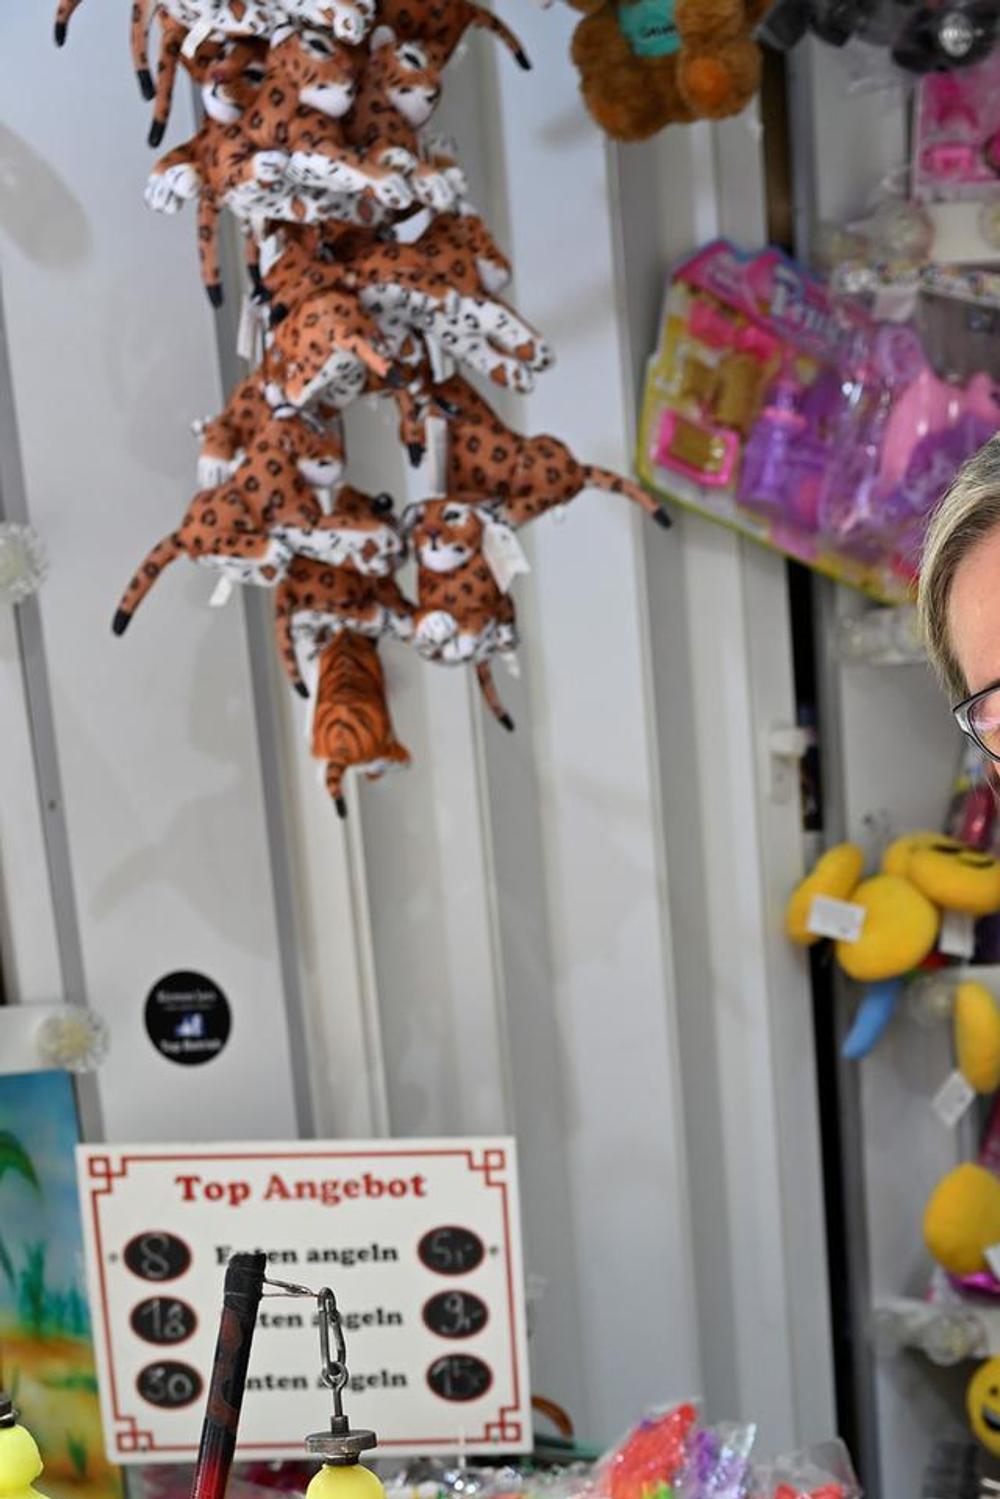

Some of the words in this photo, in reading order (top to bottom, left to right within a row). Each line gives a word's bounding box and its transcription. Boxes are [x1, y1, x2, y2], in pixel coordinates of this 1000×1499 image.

[175, 1175, 251, 1206] Top
[264, 1172, 427, 1205] Angebot
[140, 1232, 170, 1279] 8
[306, 1243, 398, 1267] angeln
